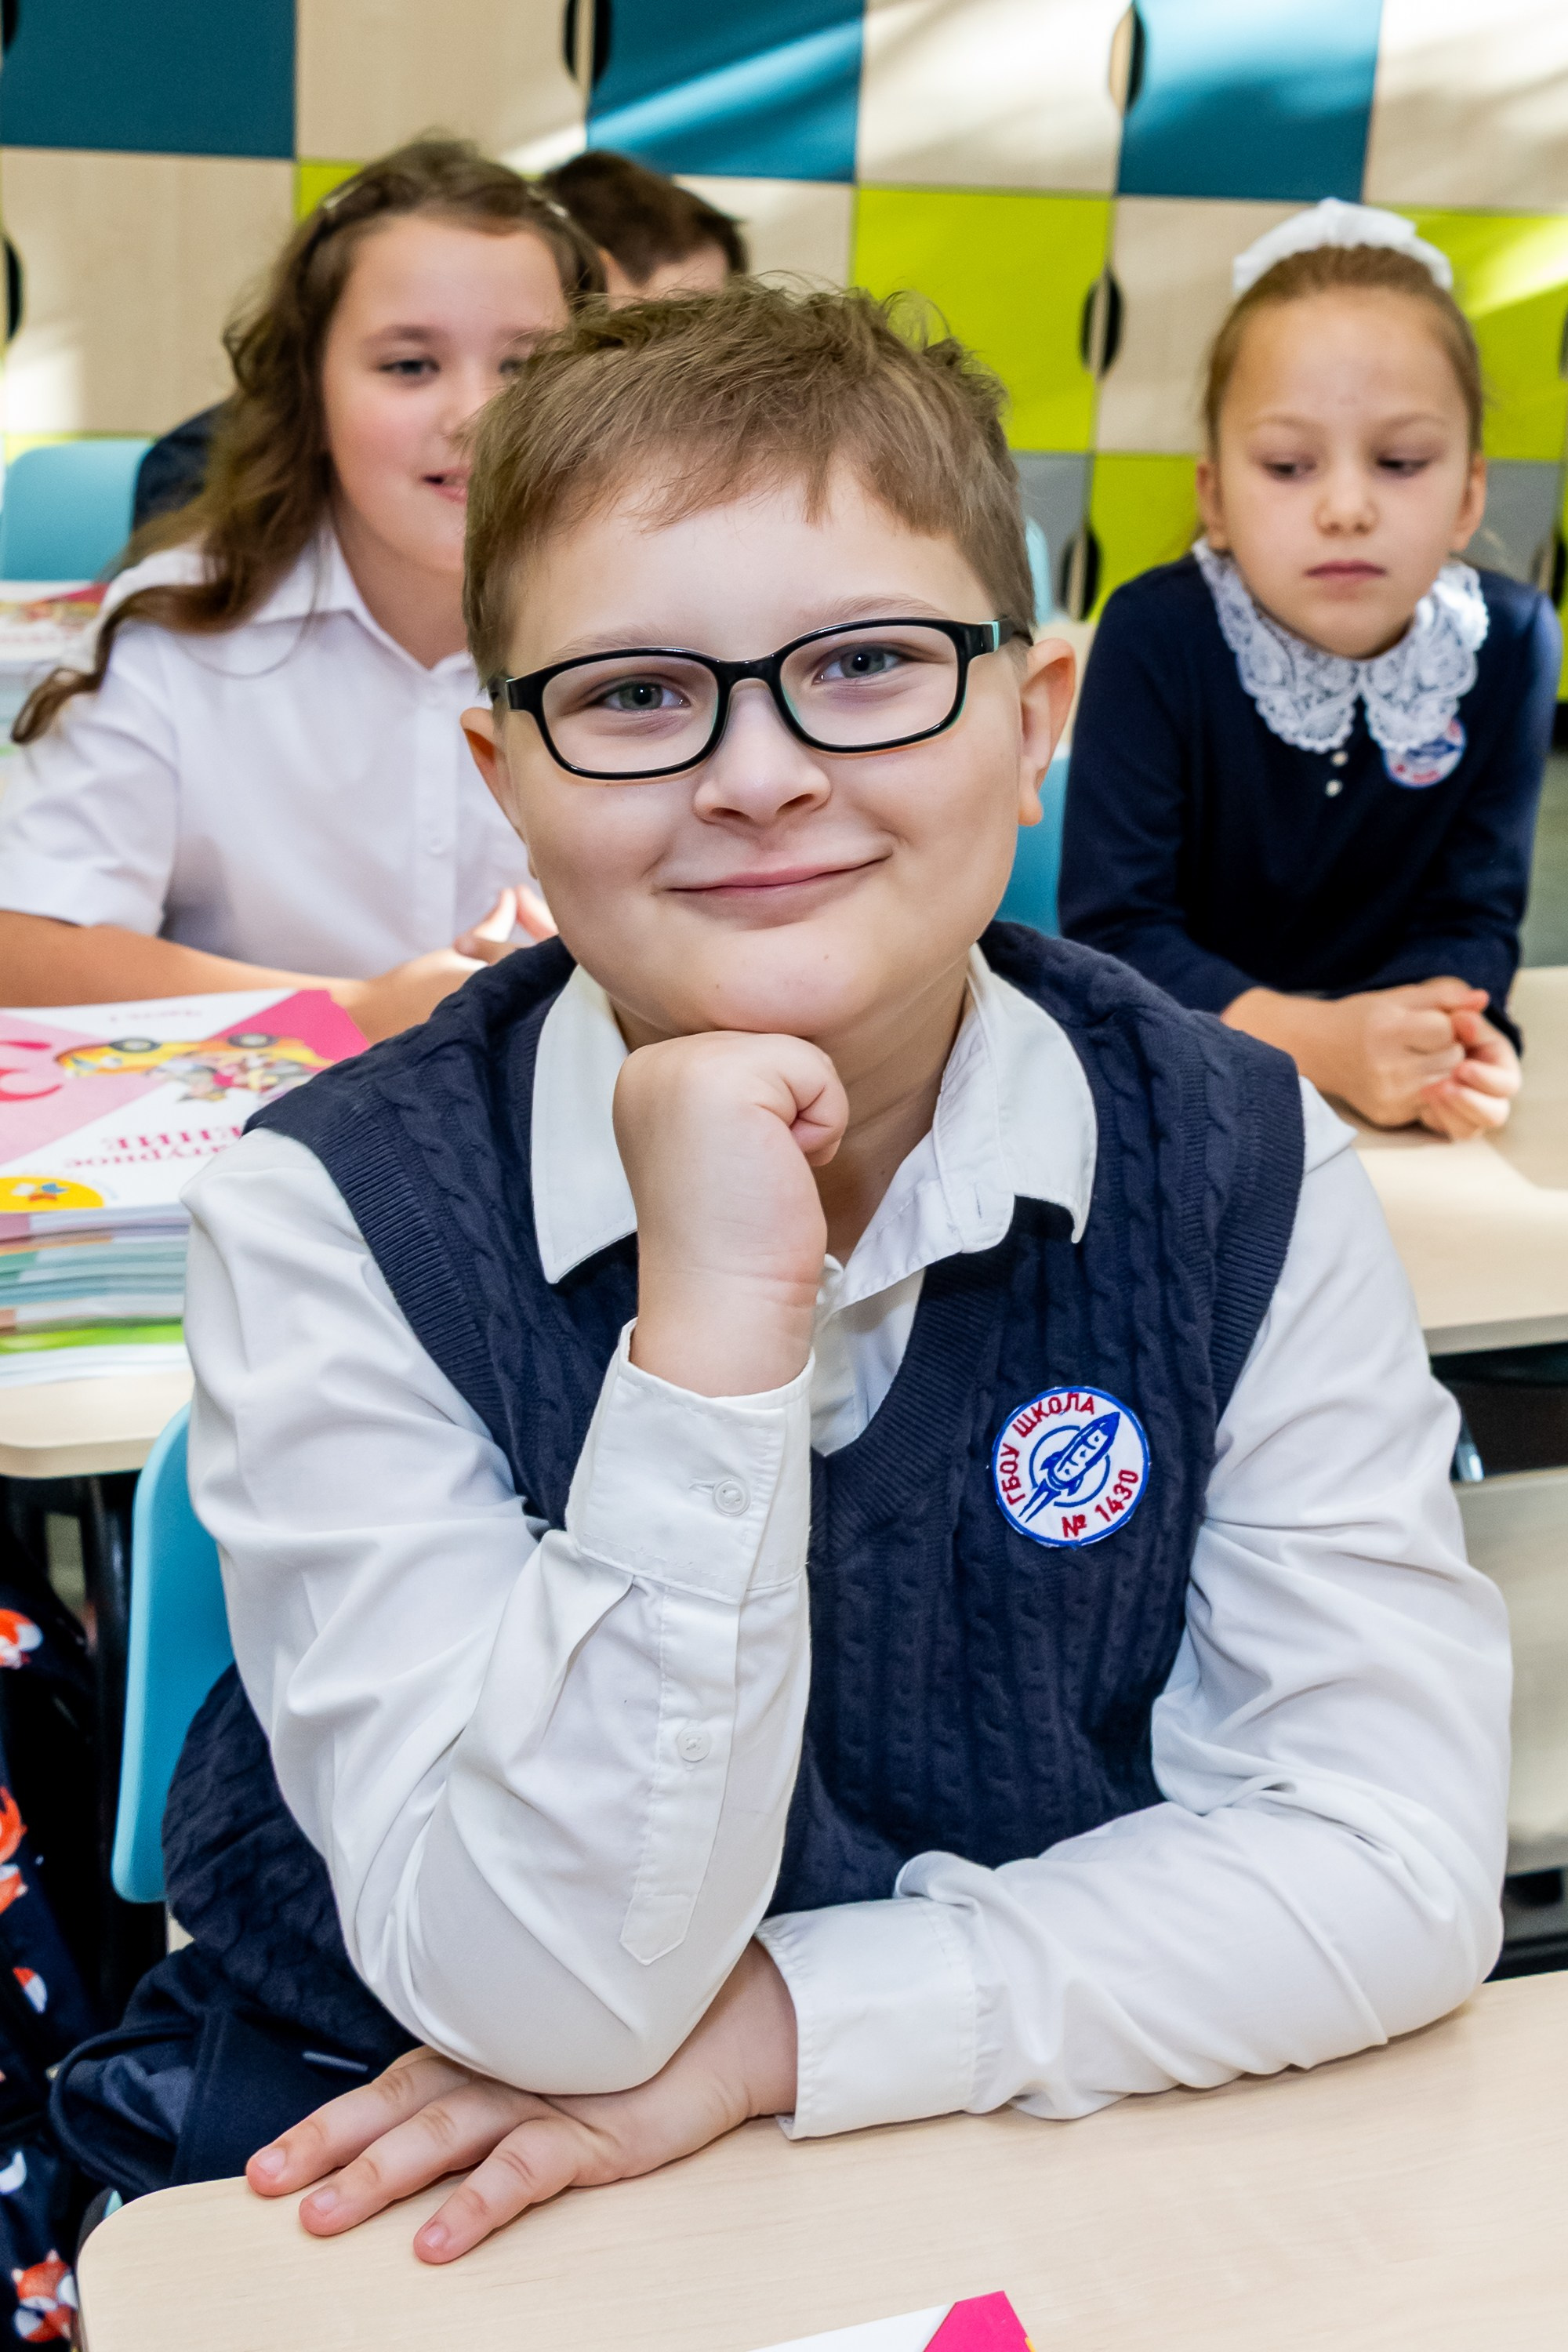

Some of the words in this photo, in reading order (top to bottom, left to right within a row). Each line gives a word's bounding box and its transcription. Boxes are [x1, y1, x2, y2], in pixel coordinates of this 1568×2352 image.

[1012, 1392, 1094, 1438] ШКОЛА
[1000, 1443, 1025, 1505] ГБОУ
[1062, 1514, 1087, 1538] №
[1094, 1469, 1139, 1523] 1430
